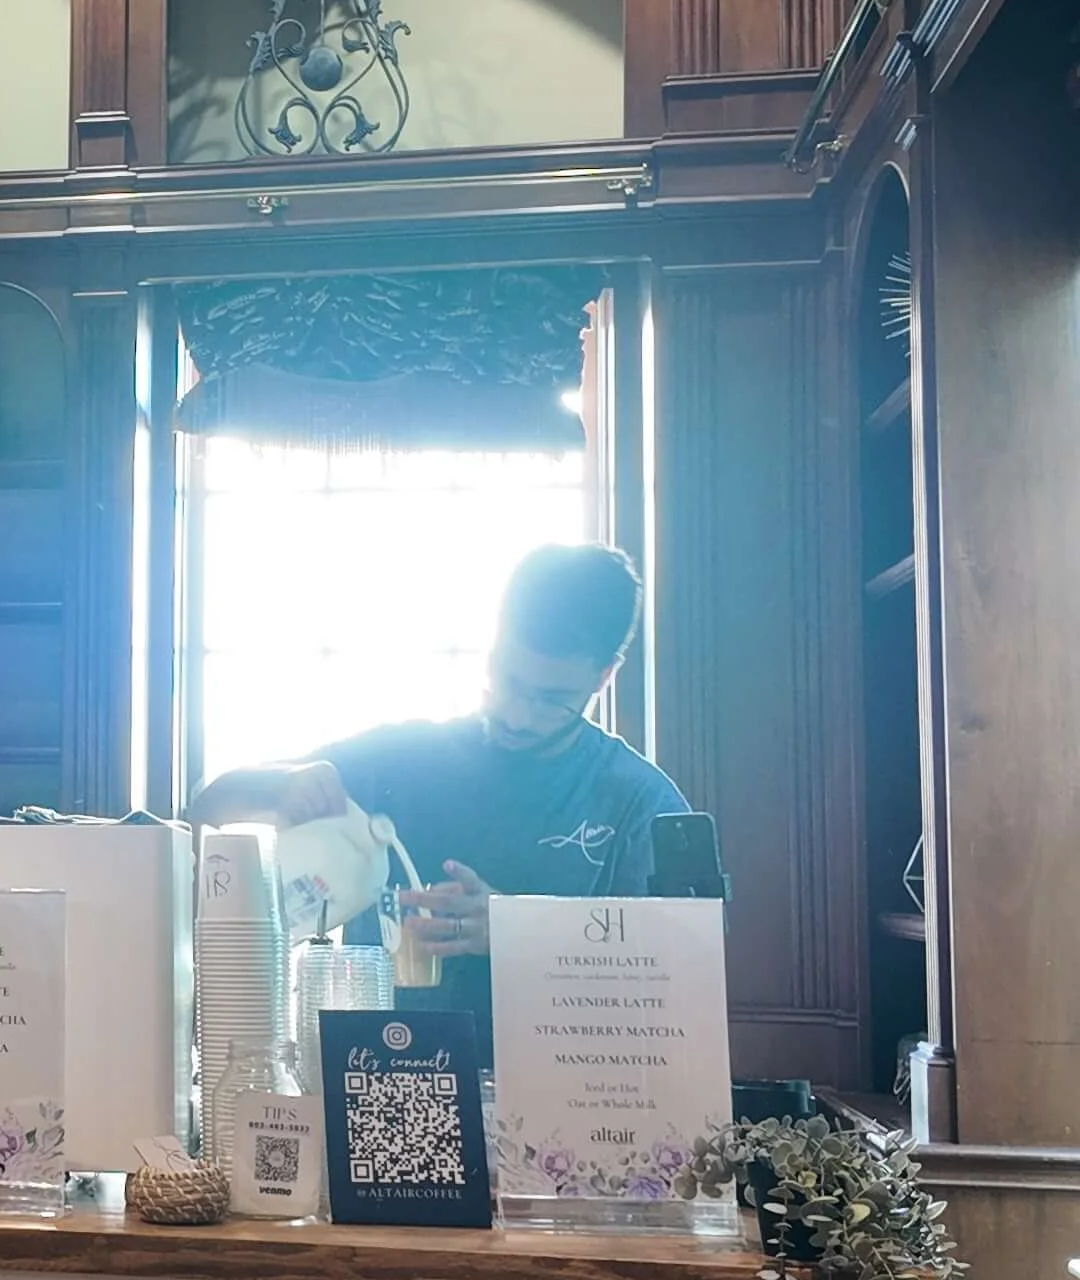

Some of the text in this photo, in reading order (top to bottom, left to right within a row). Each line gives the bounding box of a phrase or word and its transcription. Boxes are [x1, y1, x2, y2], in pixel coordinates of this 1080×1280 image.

[556, 955, 659, 968] TURKISH LATTE
[552, 996, 666, 1009] LAVENDER LATTE
[535, 1025, 686, 1038] STRAWBERRY MATCHA
[554, 1053, 669, 1066] MANGO MATCHA
[261, 1105, 298, 1121] TIPS
[590, 1127, 637, 1145] altair
[258, 1186, 293, 1197] venmo
